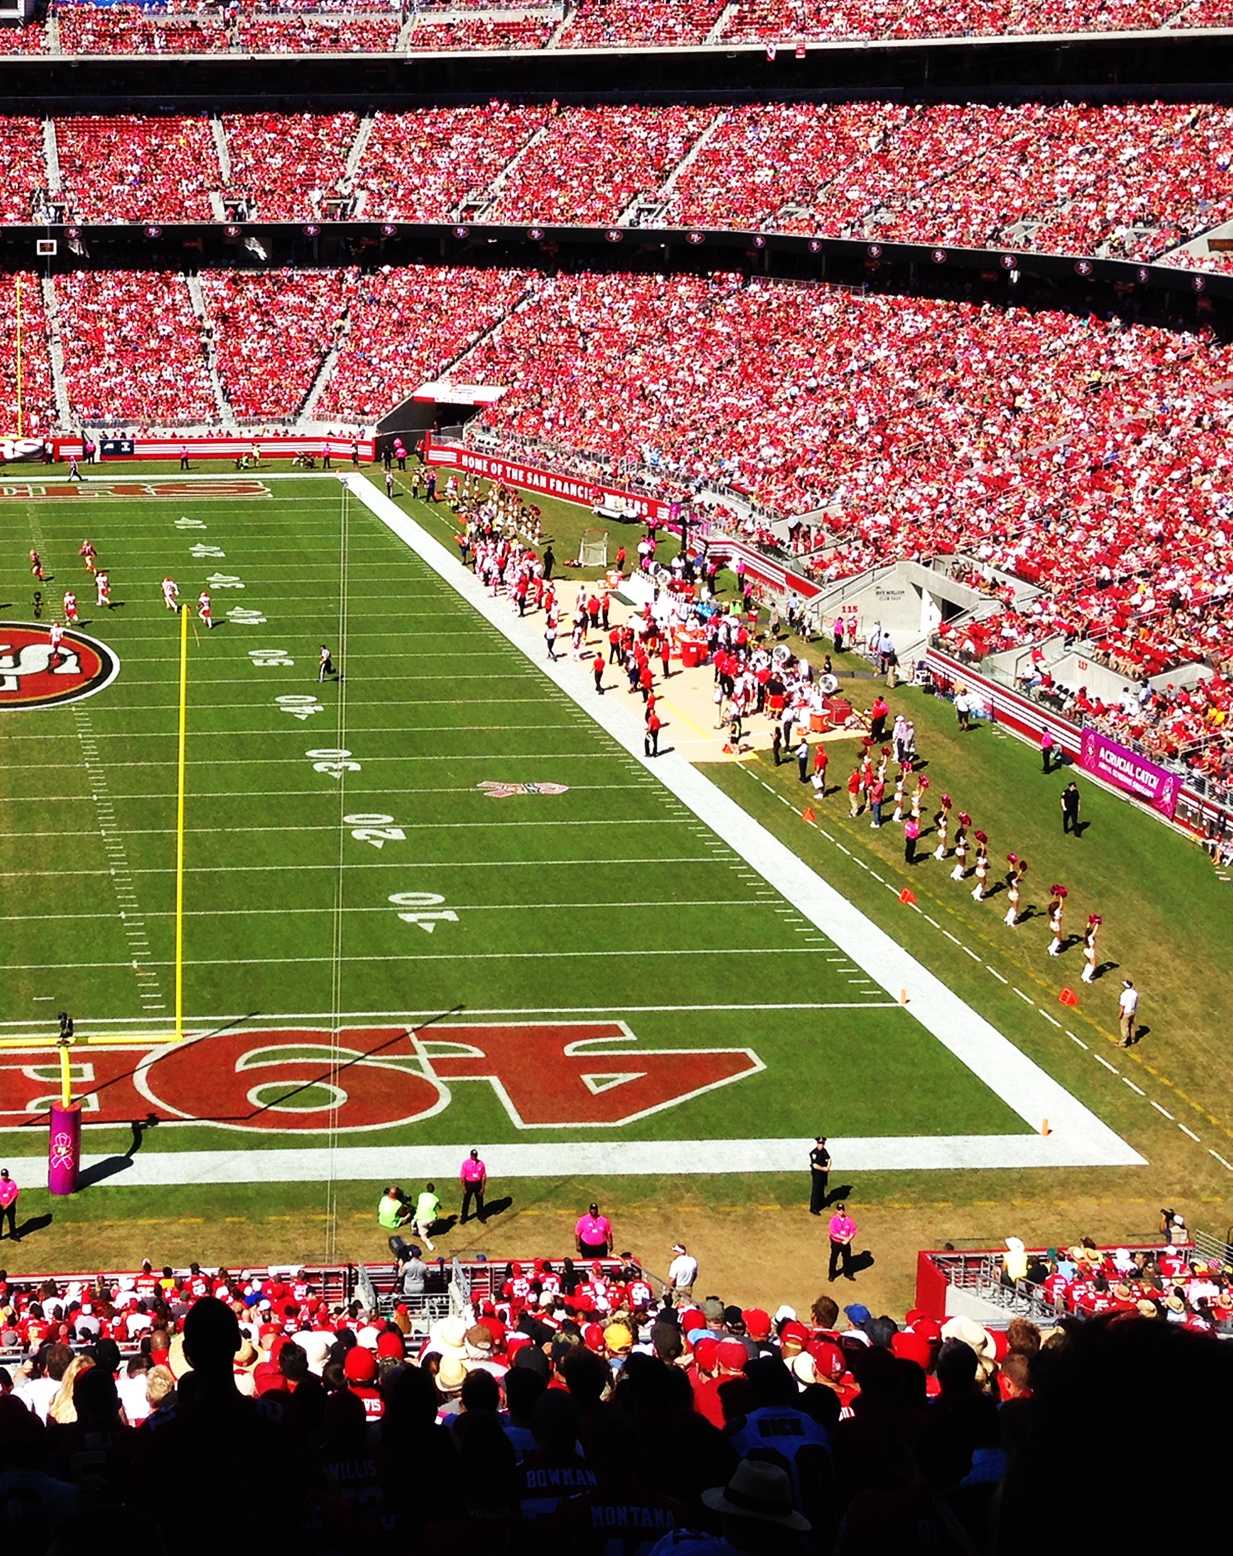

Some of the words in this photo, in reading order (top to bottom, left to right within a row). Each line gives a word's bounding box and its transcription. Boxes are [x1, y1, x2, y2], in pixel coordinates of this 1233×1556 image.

[461, 454, 489, 472] HOME
[490, 462, 504, 476] OF
[506, 467, 525, 482] THE
[526, 472, 548, 488] SAN
[841, 604, 858, 614] 115
[247, 649, 295, 667] 50
[304, 748, 362, 774] 30
[1099, 746, 1106, 760] A
[1105, 749, 1135, 778] CRUCIAL
[1135, 767, 1161, 791] CATCH
[342, 812, 408, 841] 20
[387, 891, 460, 923] 10
[526, 1466, 599, 1489] BOWMAN
